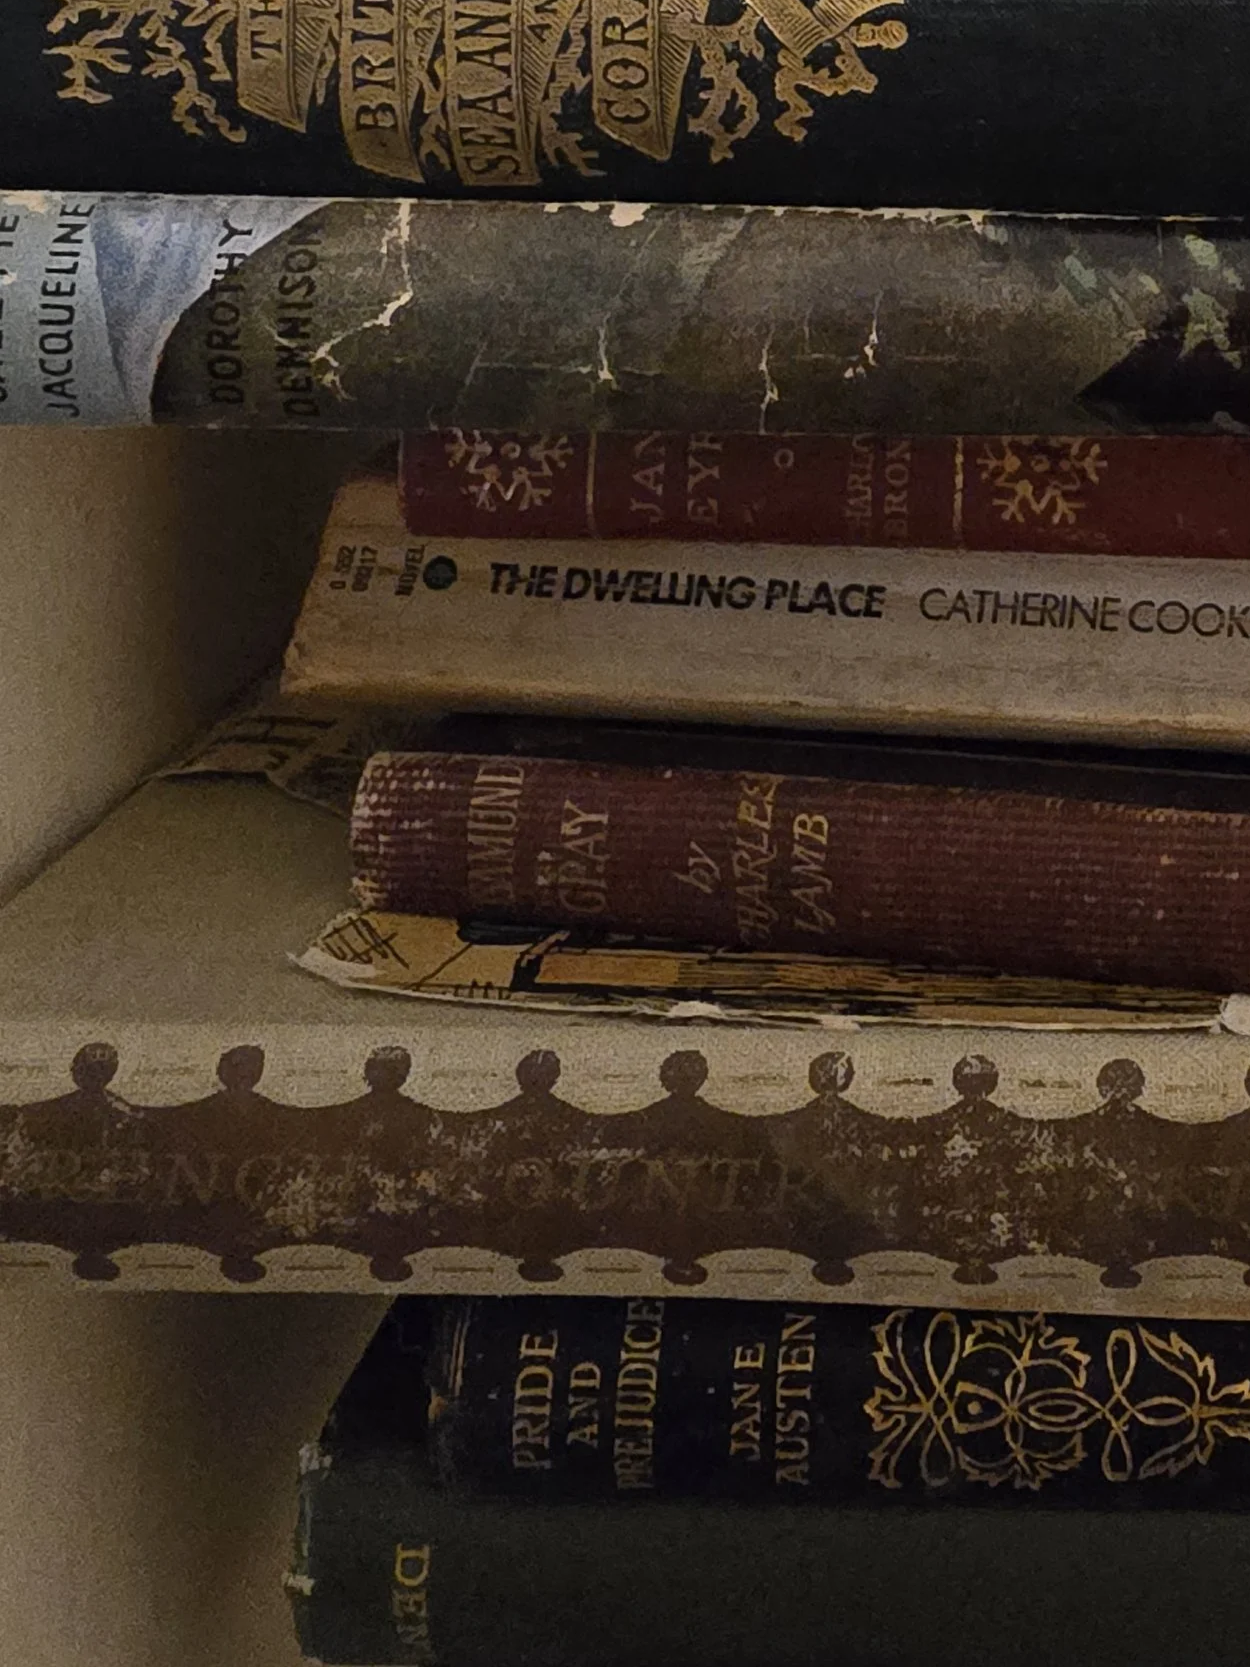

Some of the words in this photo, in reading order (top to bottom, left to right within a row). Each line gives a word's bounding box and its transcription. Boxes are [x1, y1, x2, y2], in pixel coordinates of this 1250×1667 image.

[37, 202, 97, 419] JACQUELINE
[207, 218, 254, 406] DOROTHY
[394, 543, 426, 597] NOVEL
[489, 561, 558, 599] THE
[562, 567, 757, 610] DWELLING
[763, 577, 889, 619] PLACE
[918, 586, 1122, 633] CATHERINE
[558, 798, 611, 915] GRAY
[671, 840, 721, 896] by
[731, 771, 785, 947] CHARLES
[789, 812, 837, 936] LAMB
[512, 1328, 558, 1470] PRIDE
[567, 1360, 601, 1448] AND
[613, 1298, 665, 1490] PREJUDICE
[728, 1342, 766, 1462] JANE
[775, 1311, 818, 1486] AUSTEN
